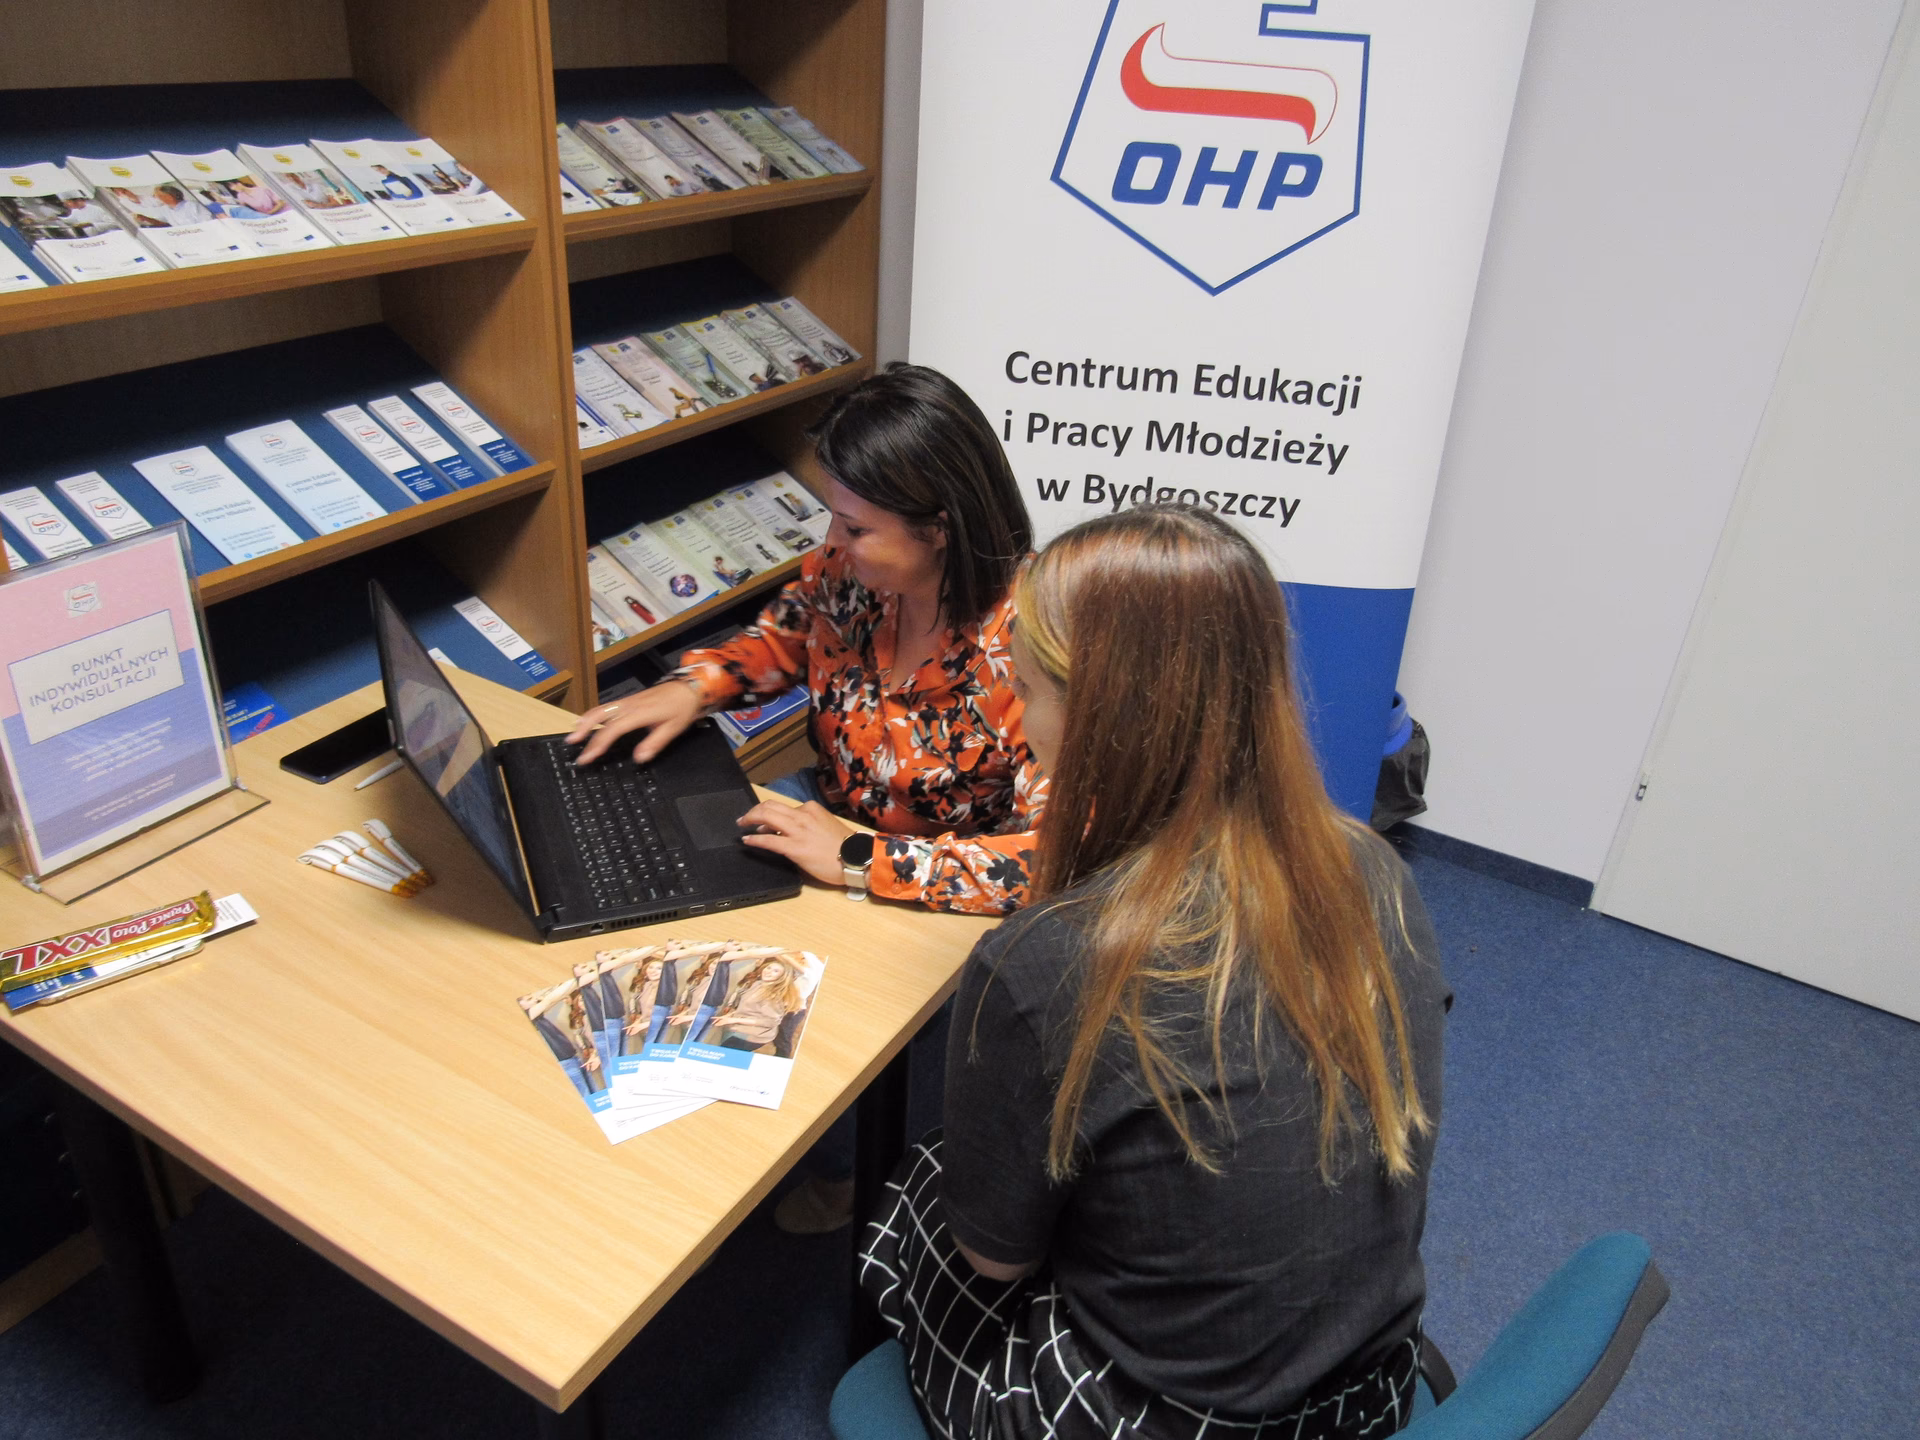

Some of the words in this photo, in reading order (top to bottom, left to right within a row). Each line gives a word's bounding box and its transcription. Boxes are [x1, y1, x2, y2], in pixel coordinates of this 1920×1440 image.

[1111, 141, 1324, 211] OHP
[1005, 351, 1178, 394] Centrum
[1193, 364, 1362, 416] Edukacji
[1003, 409, 1013, 442] i
[1027, 412, 1133, 457] Pracy
[1145, 420, 1350, 475] Młodzieży
[1036, 478, 1071, 502] w
[39, 522, 61, 534] OHP
[29, 646, 169, 708] INDYWIDUALNYCH
[71, 647, 124, 676] PUNKT
[50, 665, 157, 715] KONSULTACJI
[112, 920, 151, 938] POLO
[150, 902, 194, 926] PRINCE
[1, 926, 111, 975] XXL
